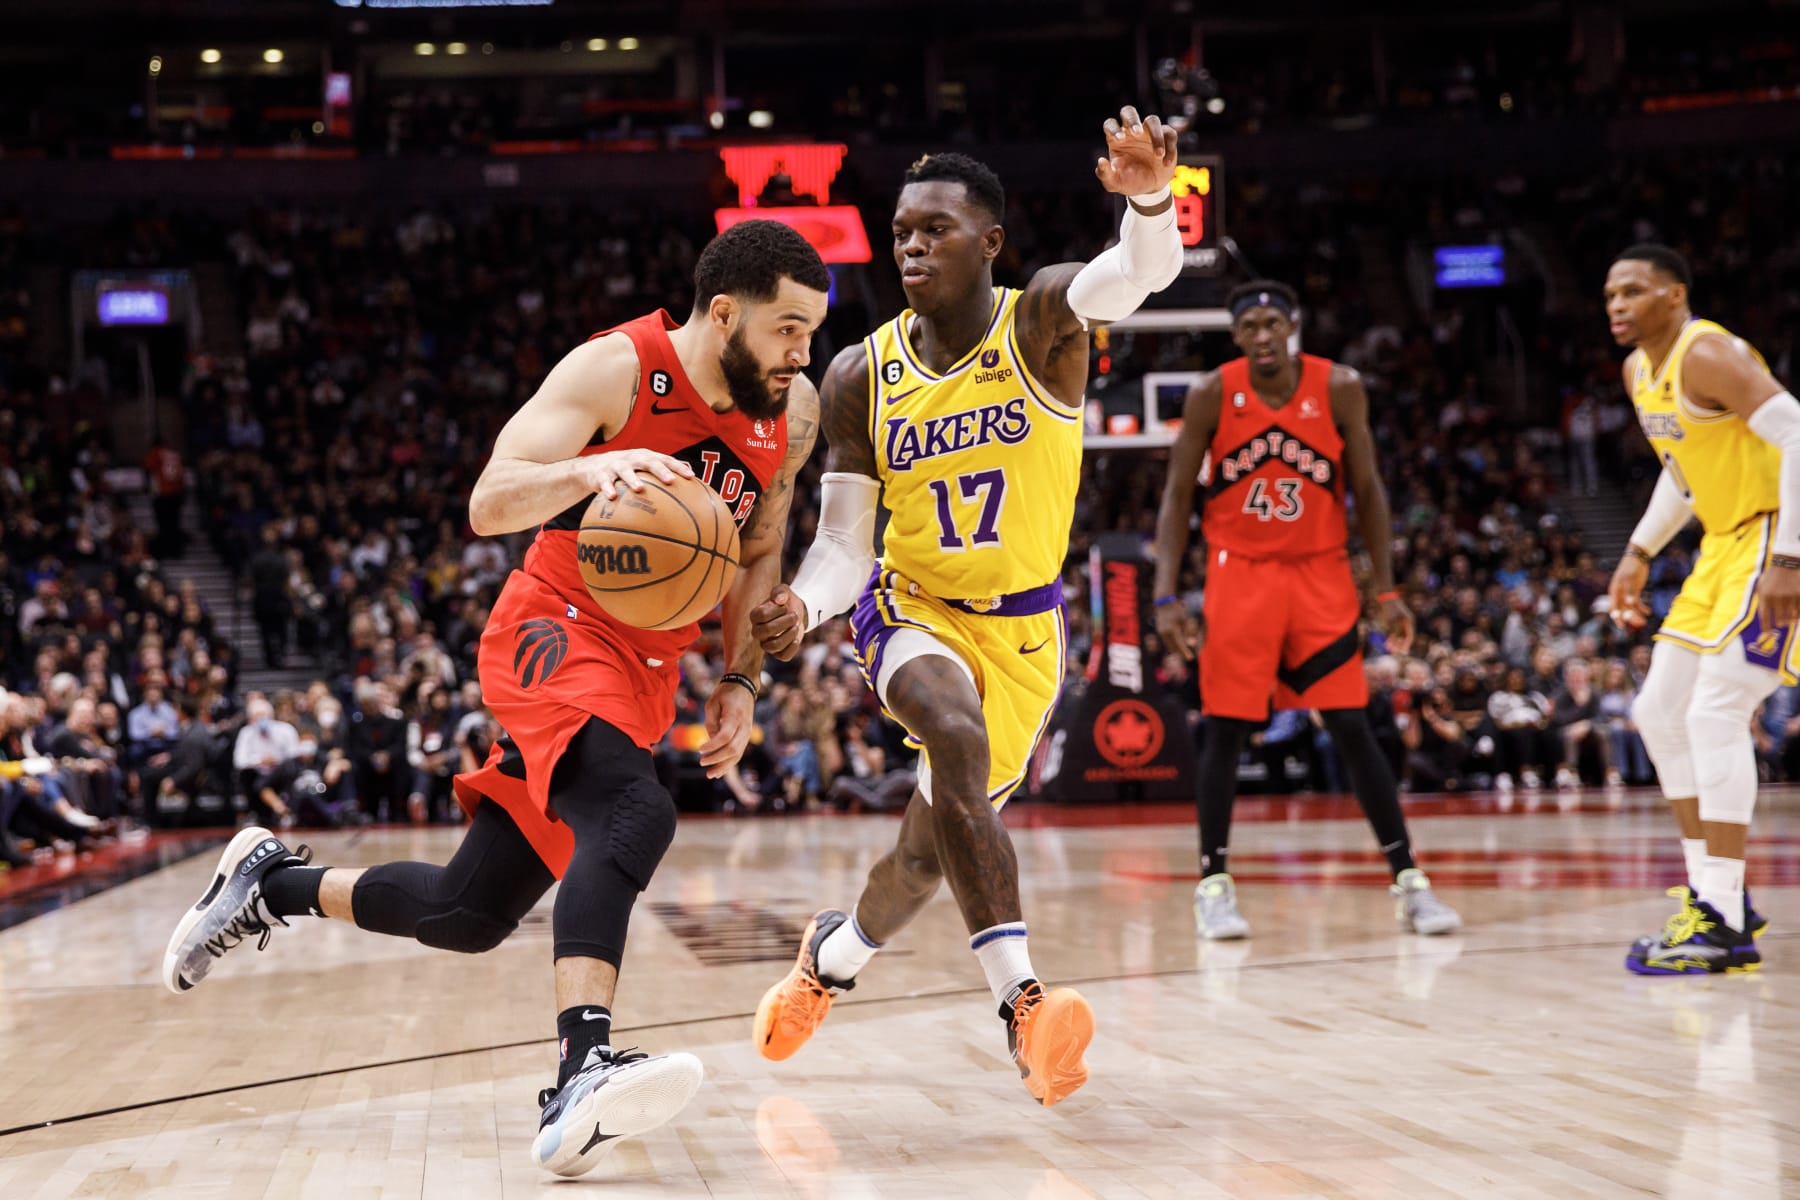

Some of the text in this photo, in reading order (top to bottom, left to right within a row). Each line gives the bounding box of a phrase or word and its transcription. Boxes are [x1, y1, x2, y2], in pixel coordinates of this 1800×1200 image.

[653, 373, 667, 395] 6
[886, 361, 900, 383] 6
[974, 368, 1013, 385] bibigo
[746, 437, 778, 450] Sun Life
[885, 398, 1032, 472] LAKERS
[1222, 432, 1330, 483] RAPTORS
[684, 451, 756, 531] TOR
[928, 467, 1008, 553] 17
[1241, 478, 1304, 522] 43
